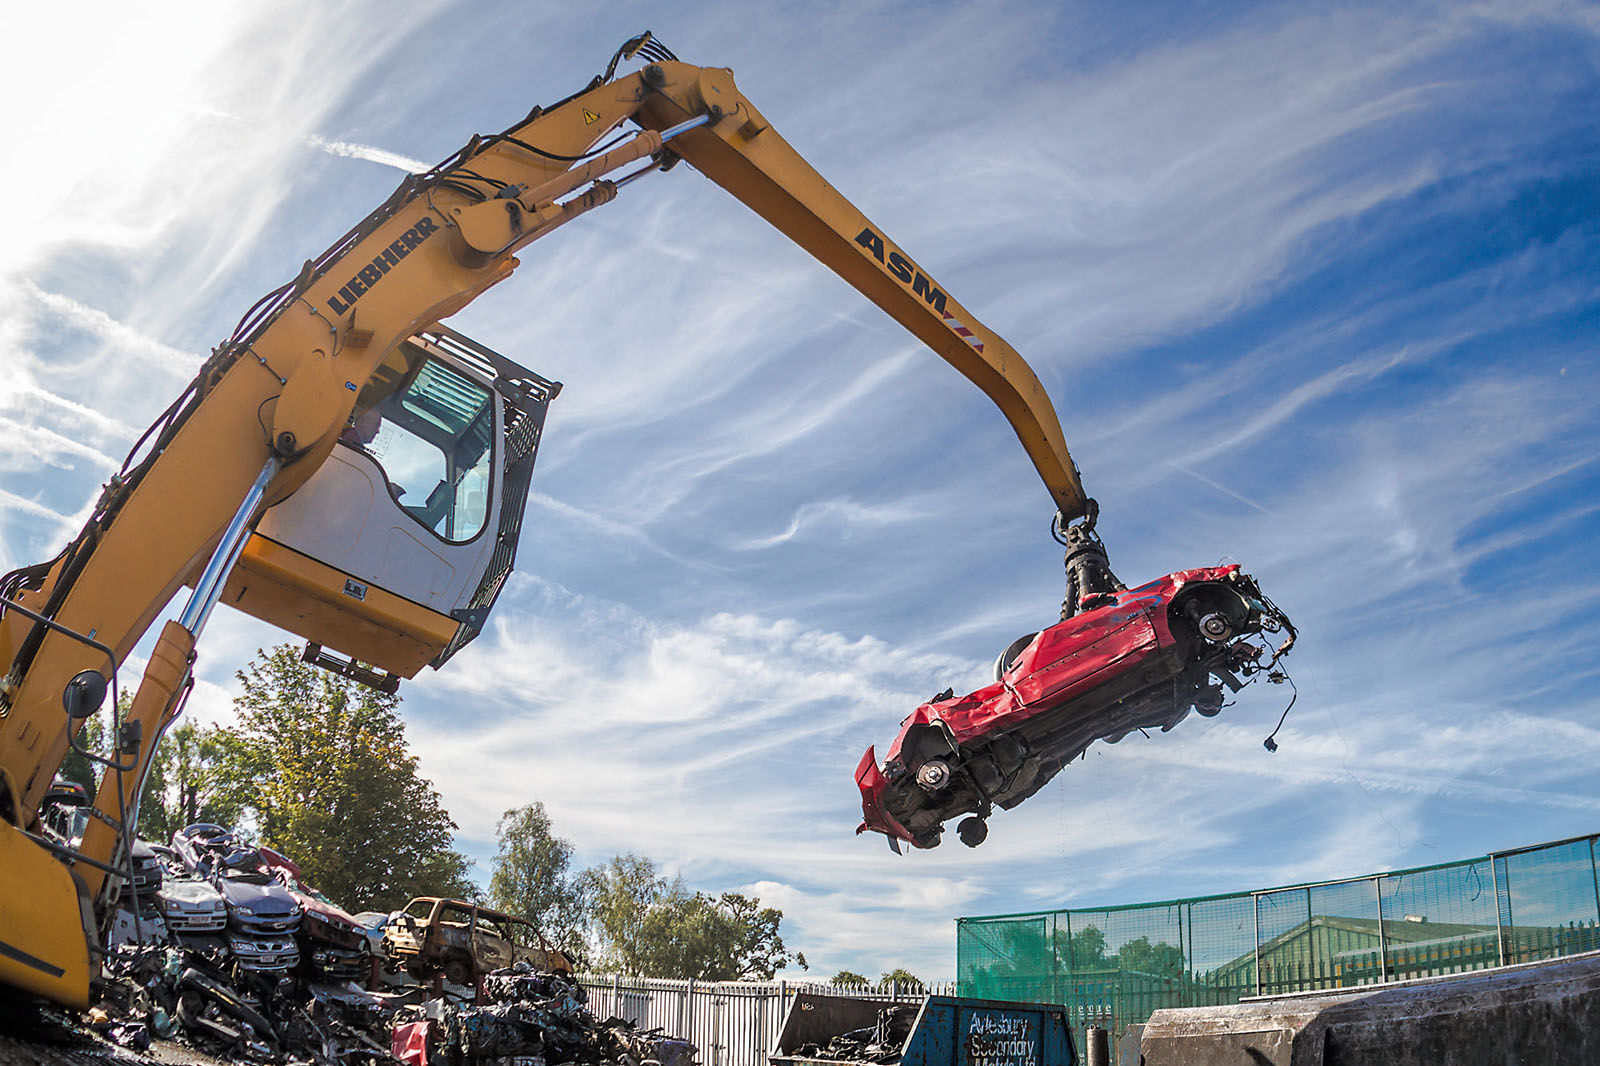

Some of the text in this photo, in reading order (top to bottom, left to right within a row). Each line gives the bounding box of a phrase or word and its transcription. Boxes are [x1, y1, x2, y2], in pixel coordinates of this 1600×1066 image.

[327, 217, 440, 316] LIEBHERR
[854, 227, 947, 316] ASM
[969, 1011, 1029, 1040] Aylesbury
